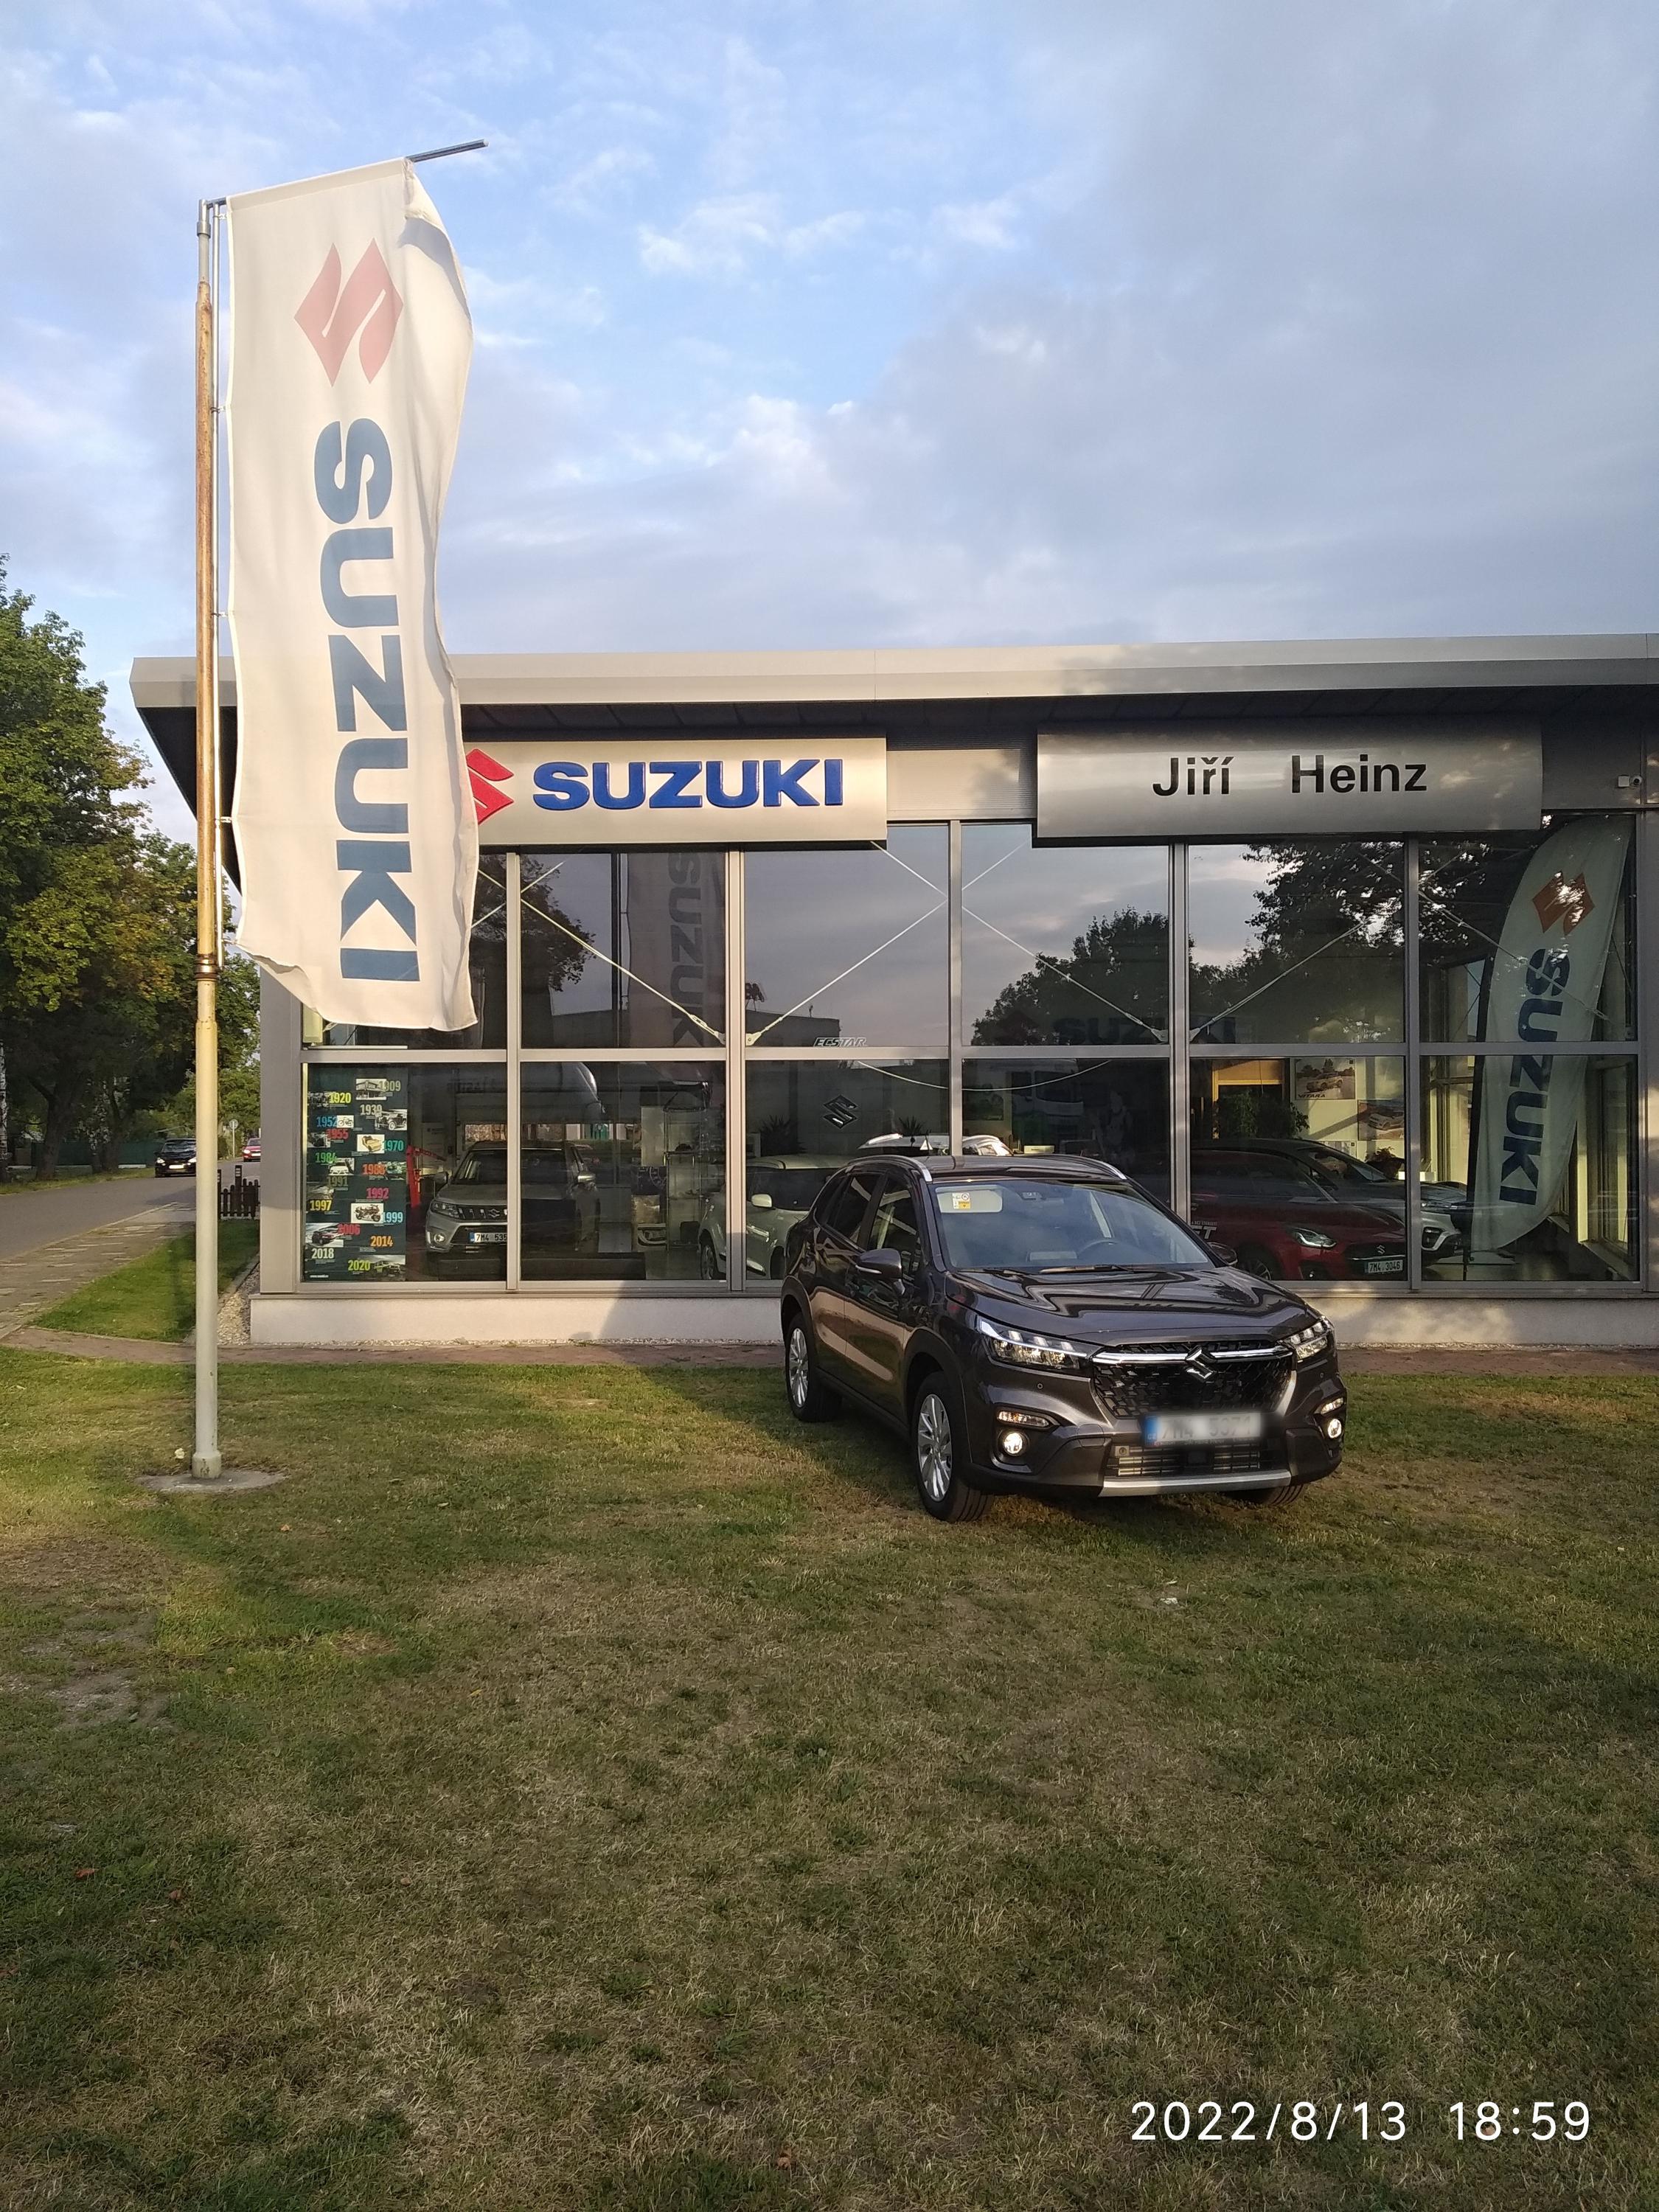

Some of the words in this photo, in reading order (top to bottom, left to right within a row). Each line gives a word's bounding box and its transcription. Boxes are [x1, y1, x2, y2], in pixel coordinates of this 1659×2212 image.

[314, 418, 420, 981] SUZUKI
[1152, 757, 1234, 796] Jiří
[1291, 754, 1427, 794] Heinz
[532, 758, 844, 810] SUZUKI
[813, 1037, 867, 1048] ECSTAR
[1499, 947, 1571, 1206] SUZUKI
[330, 1093, 352, 1104] 1920
[361, 1105, 383, 1116] 1939
[383, 1140, 404, 1152] 1970
[315, 1152, 338, 1164] 1984
[327, 1177, 349, 1187] 1991
[366, 1188, 389, 1199] 1992
[310, 1200, 332, 1211] 1997
[383, 1211, 403, 1222] 1999
[370, 1236, 394, 1247] 2014
[311, 1248, 334, 1259] 2018
[347, 1260, 371, 1271] 2020
[1385, 1261, 1401, 1271] 3046
